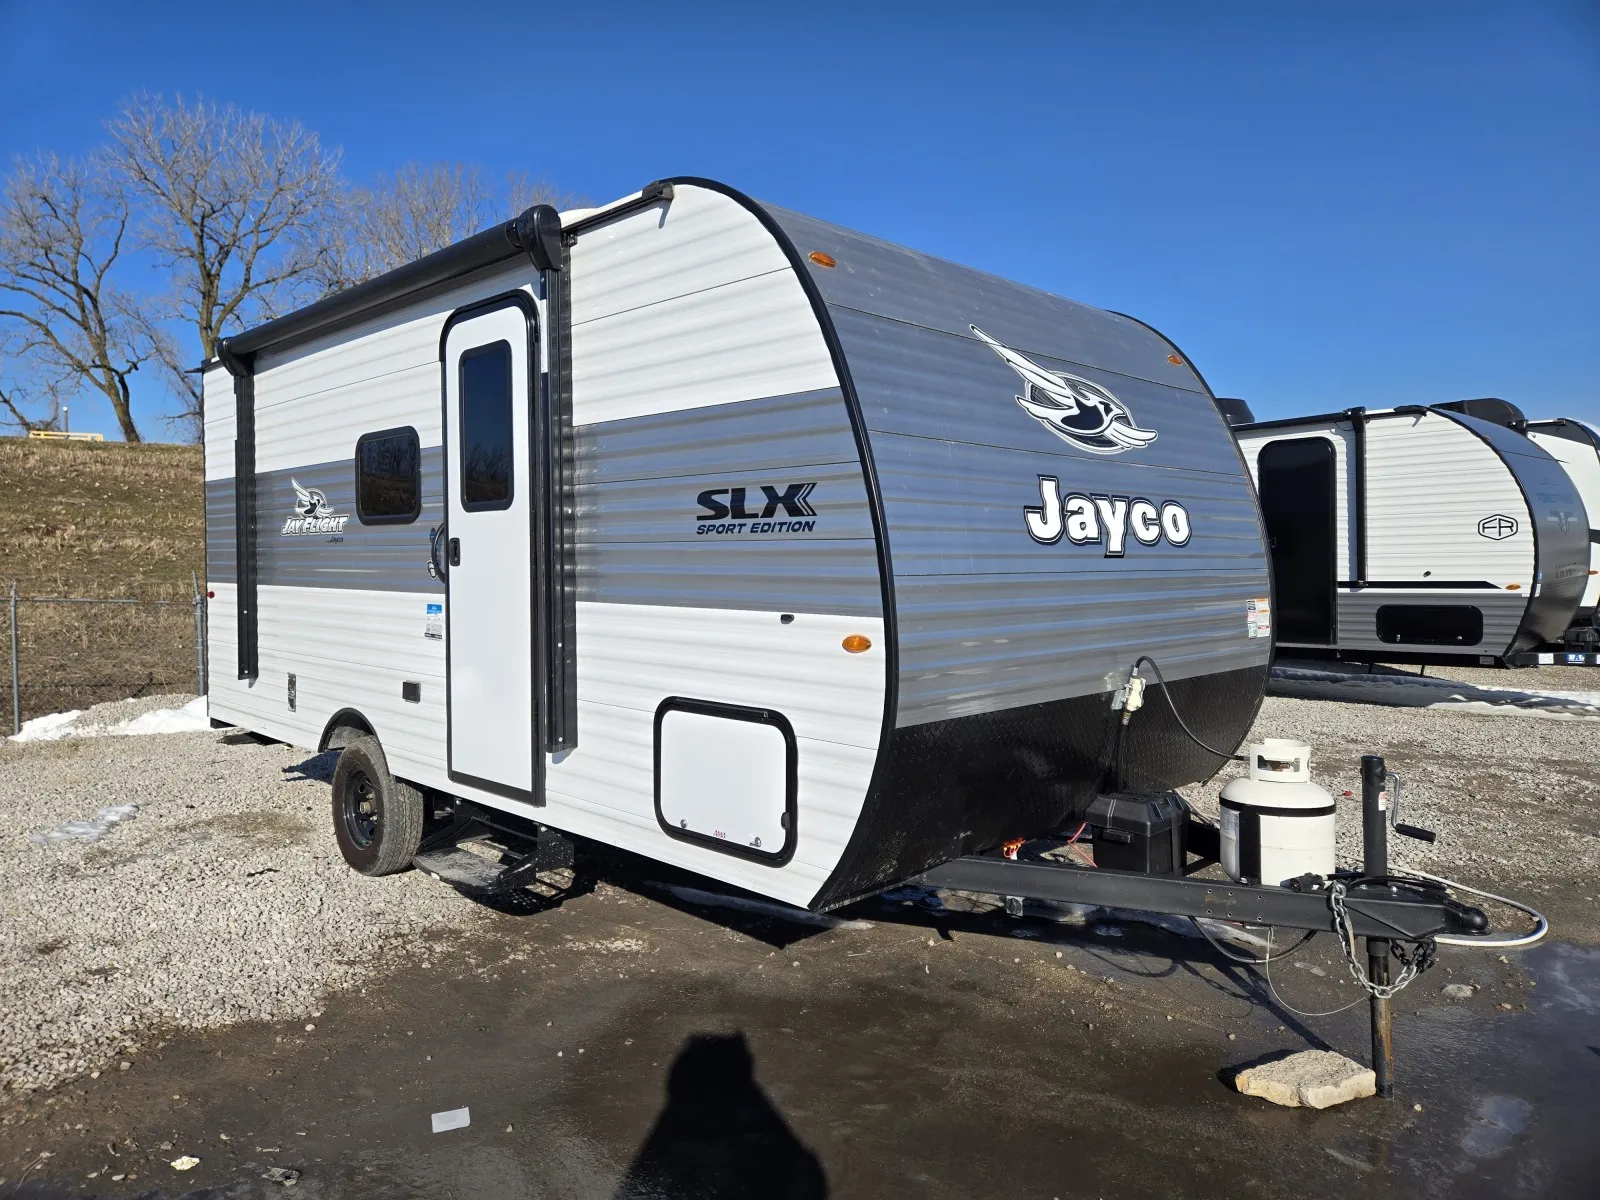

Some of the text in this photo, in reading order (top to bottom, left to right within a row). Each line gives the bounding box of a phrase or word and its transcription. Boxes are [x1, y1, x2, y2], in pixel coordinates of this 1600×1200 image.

[696, 482, 818, 521] SLX
[1023, 474, 1192, 558] Jayco
[281, 514, 350, 536] JAY FLIGHT
[696, 521, 816, 535] SPORT EDITION
